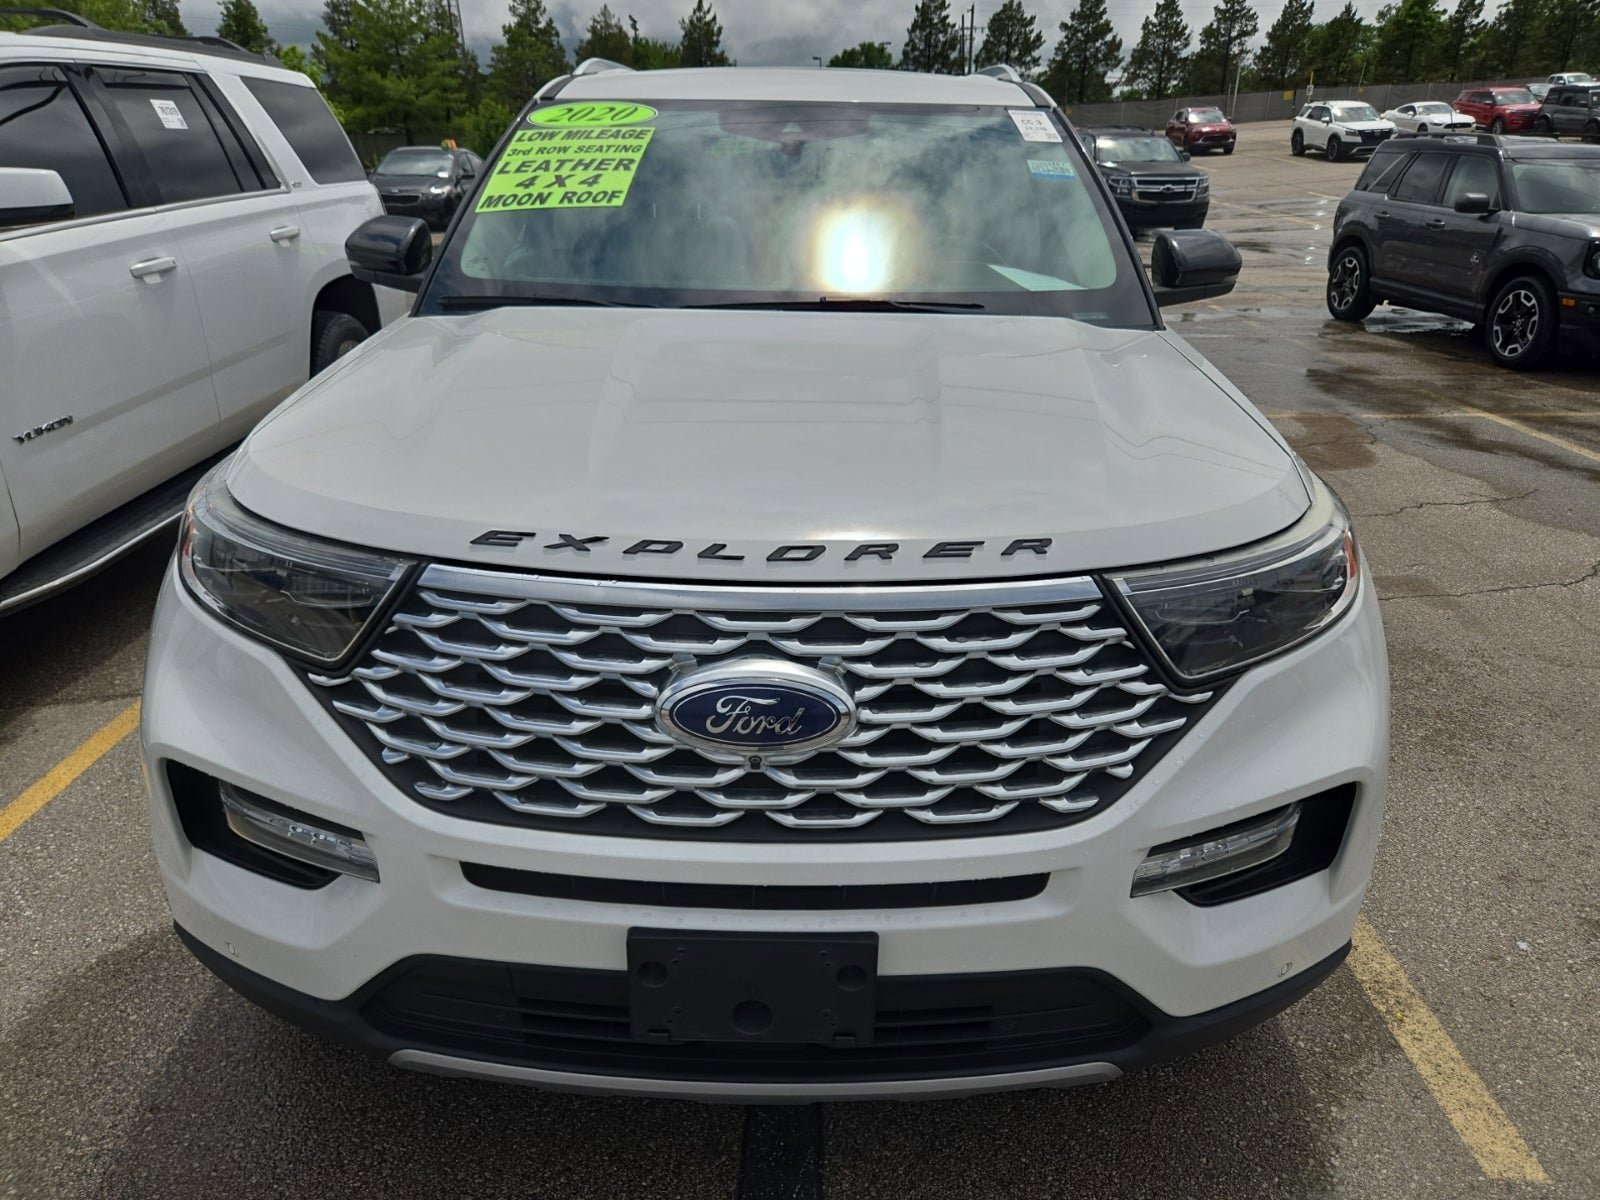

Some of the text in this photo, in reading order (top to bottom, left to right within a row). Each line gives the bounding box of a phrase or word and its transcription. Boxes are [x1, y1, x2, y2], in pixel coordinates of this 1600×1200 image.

[544, 106, 638, 123] 2020
[514, 129, 652, 143] LOW MILEAGE
[507, 144, 643, 157] 3rd ROW SEATING
[497, 158, 636, 174] LEATHER
[479, 190, 624, 209] MOON ROOF
[12, 414, 74, 444] YUKON
[469, 529, 1053, 562] EXPLORER
[705, 695, 806, 735] Ford
